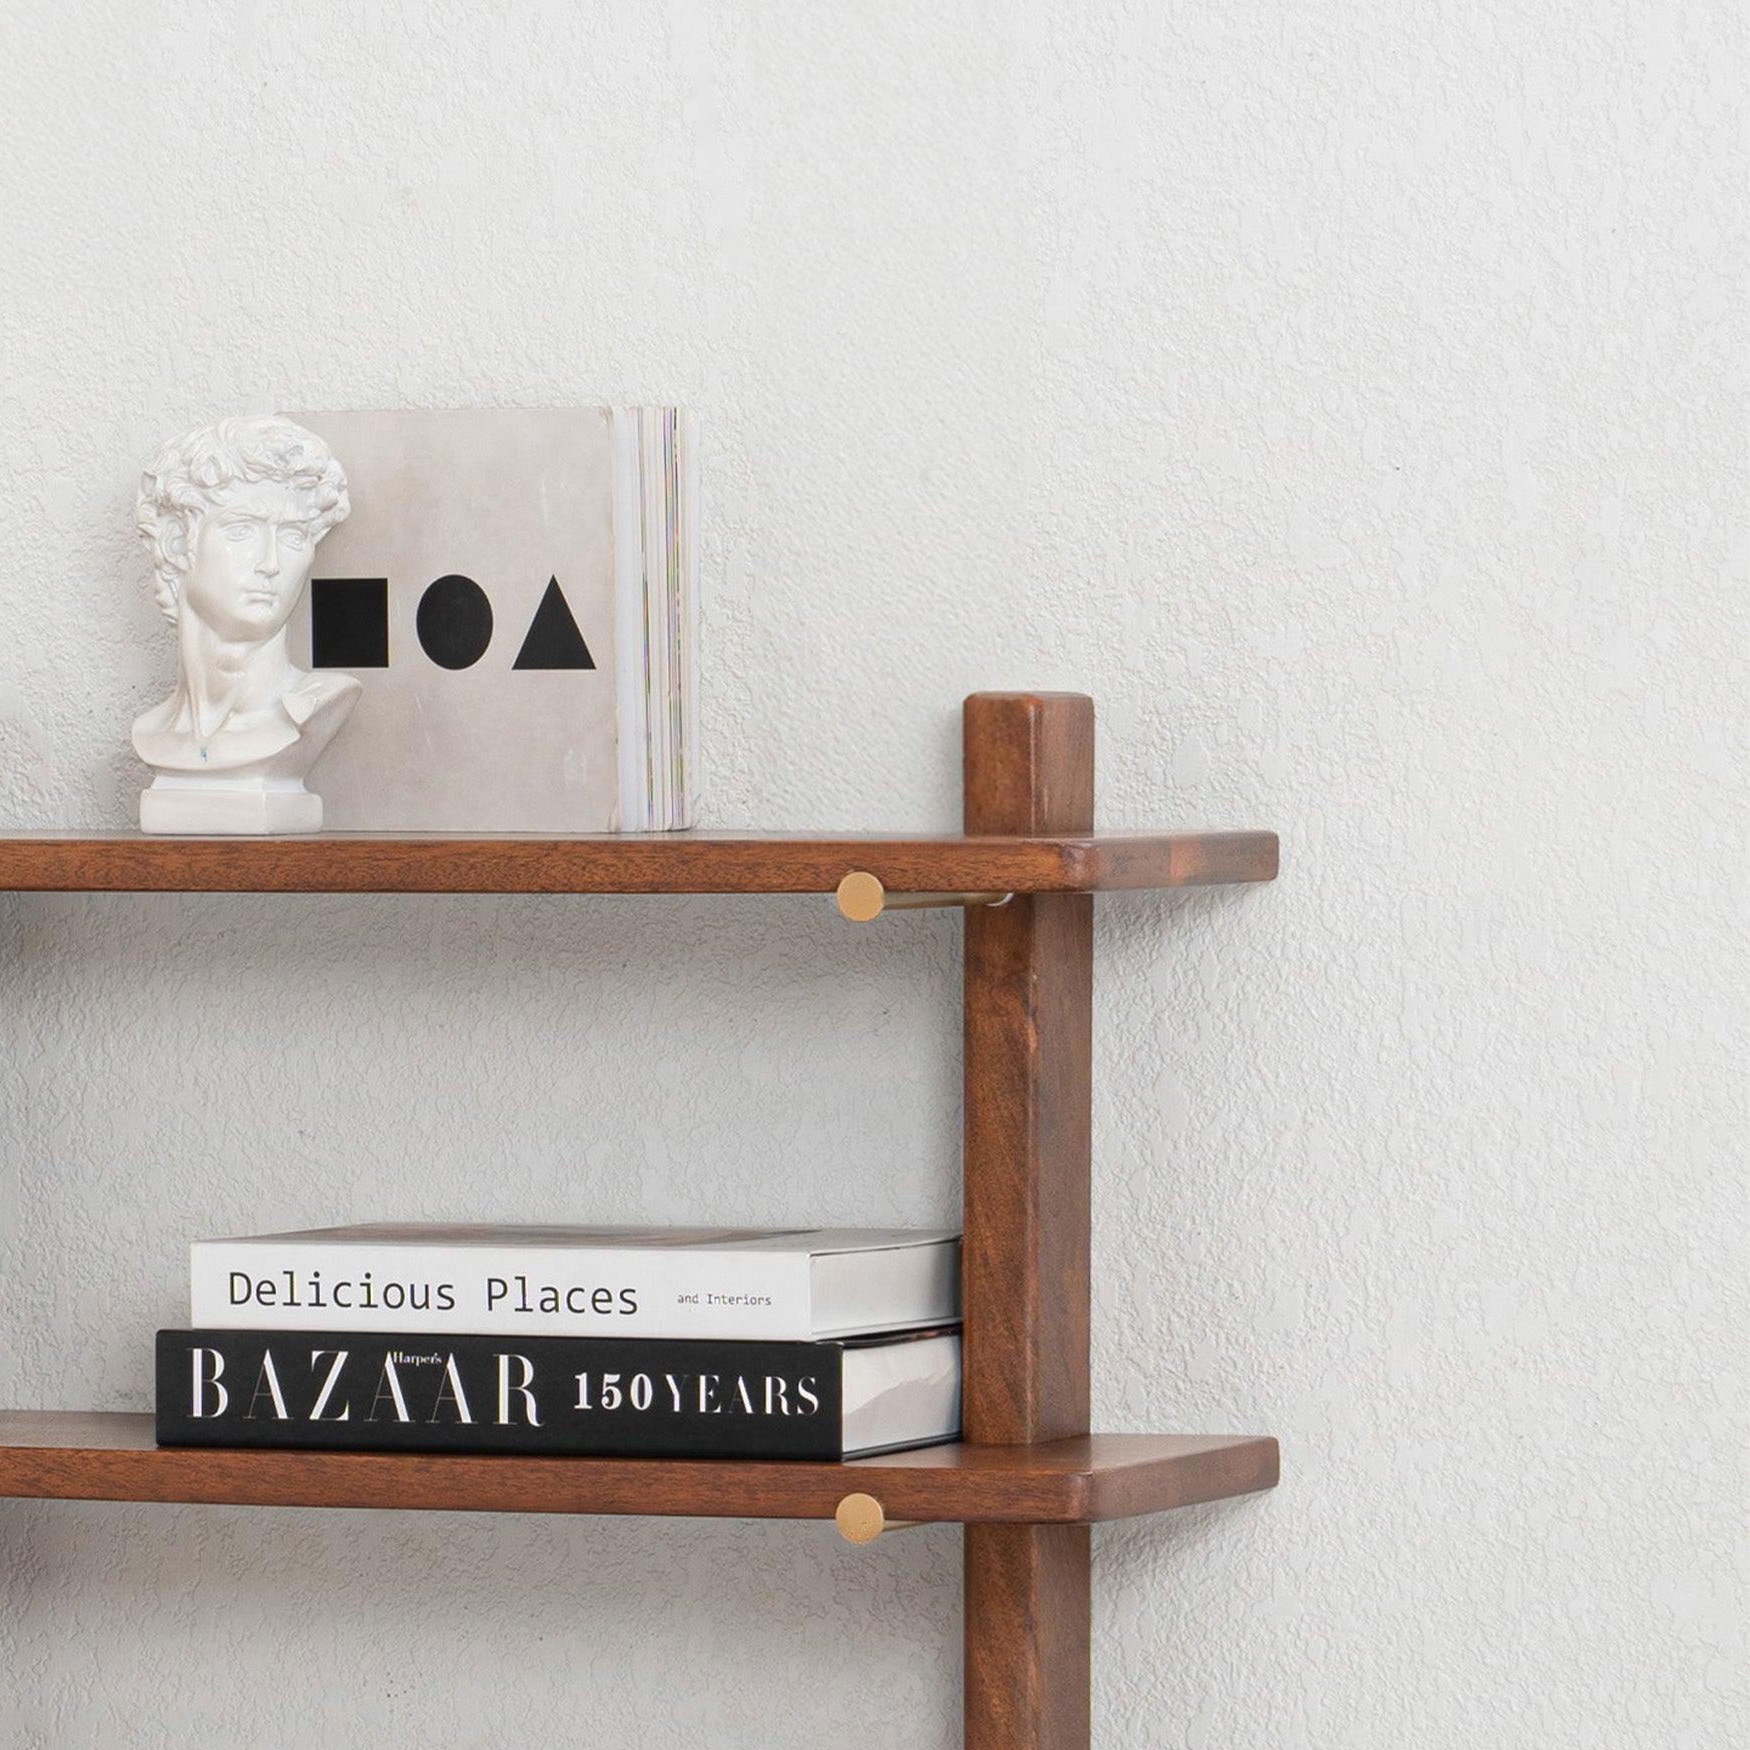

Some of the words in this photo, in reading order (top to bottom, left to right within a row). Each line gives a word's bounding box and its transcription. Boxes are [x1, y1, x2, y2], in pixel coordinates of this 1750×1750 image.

[229, 1270, 456, 1311] Delicious
[487, 1275, 638, 1315] Places
[677, 1292, 699, 1305] and
[706, 1293, 772, 1306] Interiors
[393, 1351, 442, 1367] Harper's
[186, 1347, 546, 1428] BAZAAR
[573, 1371, 654, 1411] 150
[661, 1373, 820, 1416] YEARS
